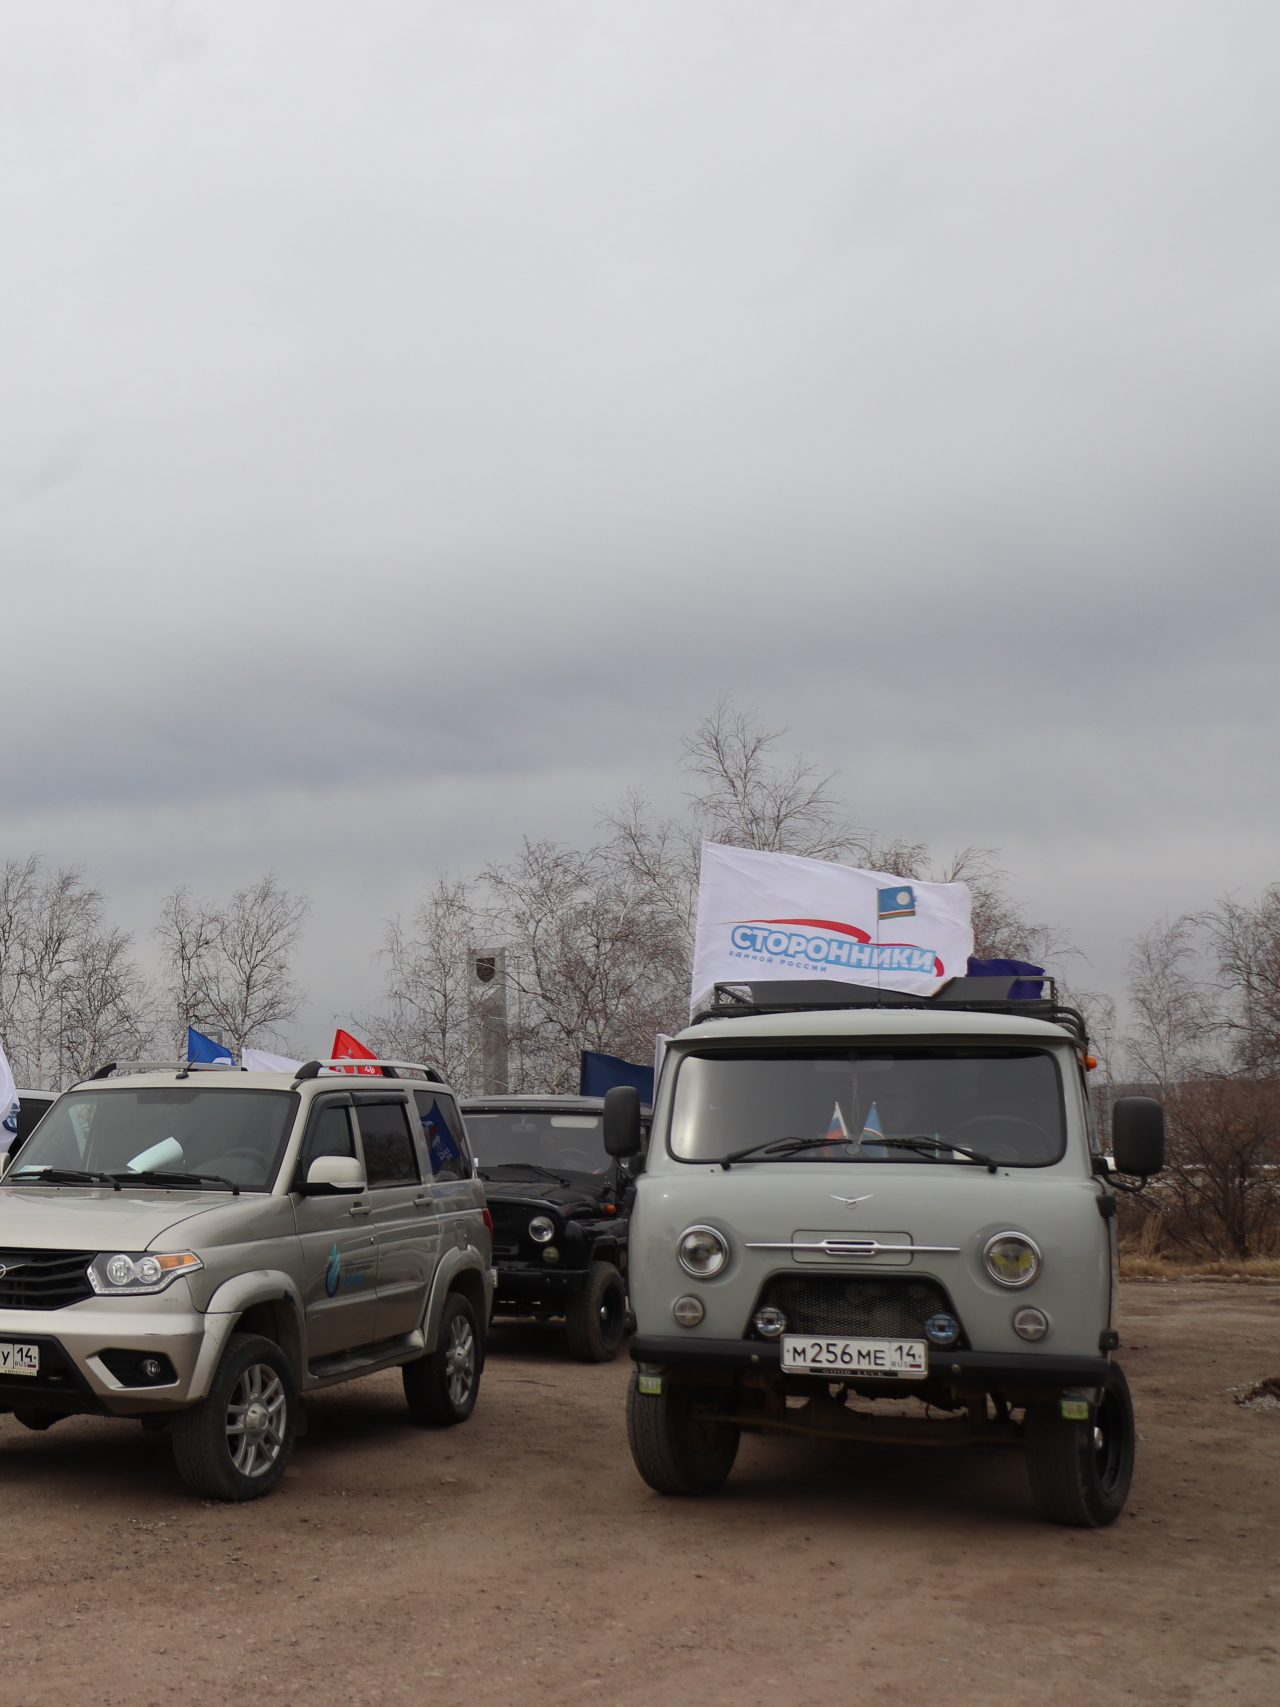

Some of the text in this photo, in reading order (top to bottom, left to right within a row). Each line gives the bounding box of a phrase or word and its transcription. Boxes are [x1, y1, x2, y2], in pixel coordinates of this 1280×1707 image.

[732, 926, 935, 973] СТОРОННИКИ
[729, 951, 827, 972] ЕДИНОЙ РОССИИ
[17, 1347, 33, 1362] 14
[793, 1343, 917, 1366] М256МЕ 14
